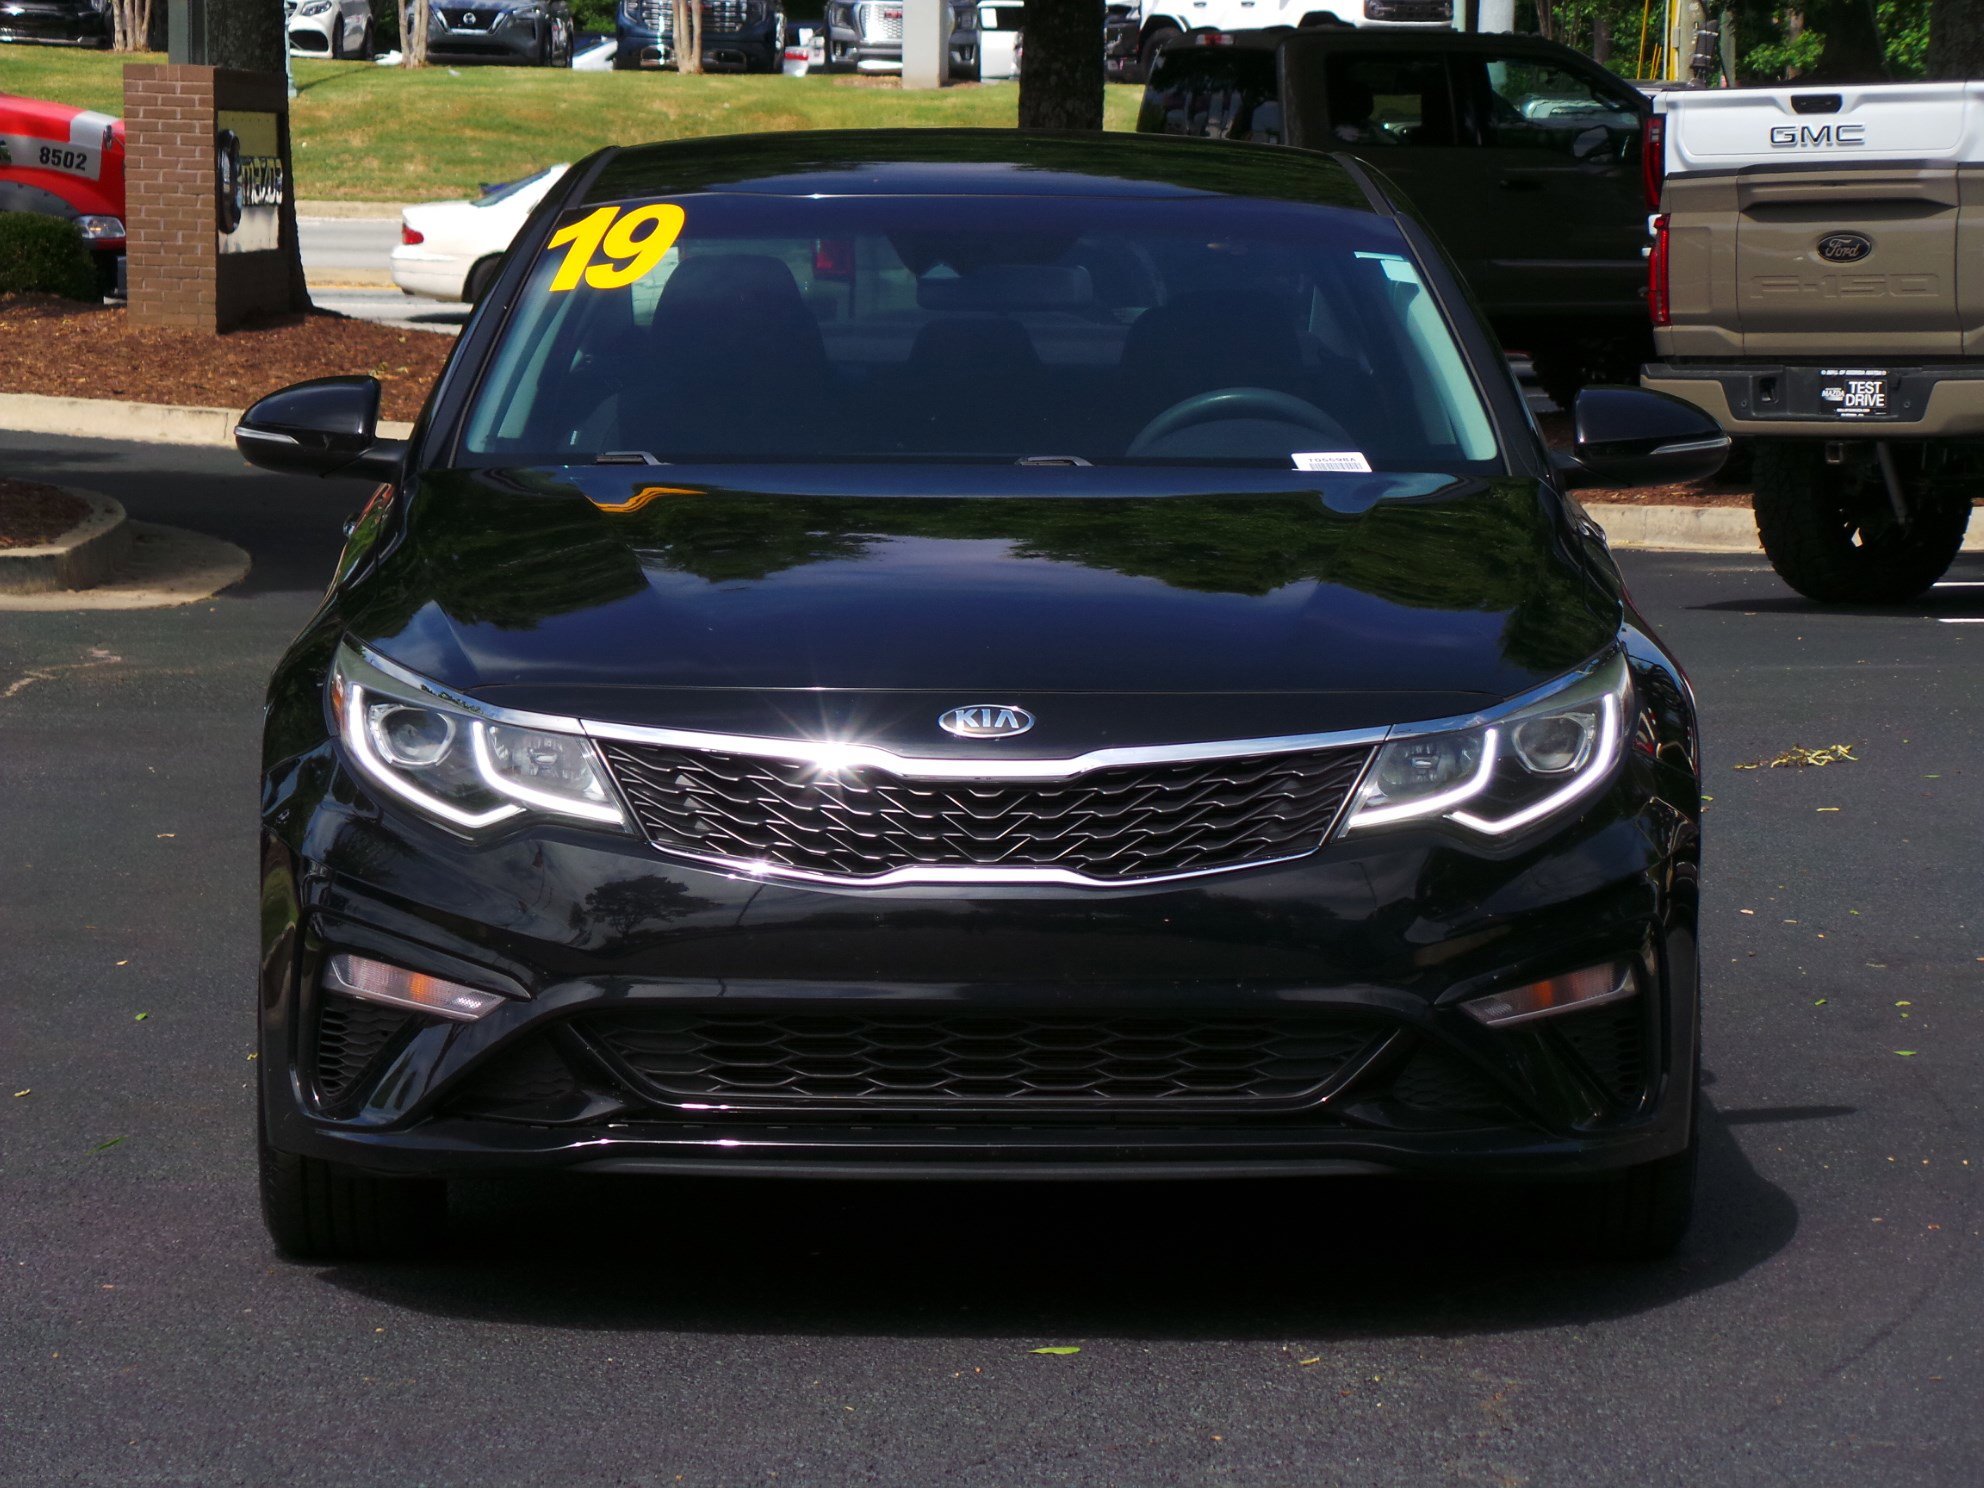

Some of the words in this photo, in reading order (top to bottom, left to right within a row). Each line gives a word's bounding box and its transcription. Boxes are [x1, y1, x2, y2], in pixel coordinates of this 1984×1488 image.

[1770, 125, 1865, 148] GMC
[39, 146, 87, 171] 8502
[547, 203, 686, 291] 19
[1824, 238, 1859, 258] Ford
[1750, 273, 1940, 298] F-150
[1848, 381, 1883, 394] TEST
[1845, 393, 1885, 407] DRIVE
[955, 708, 1020, 729] KIA
